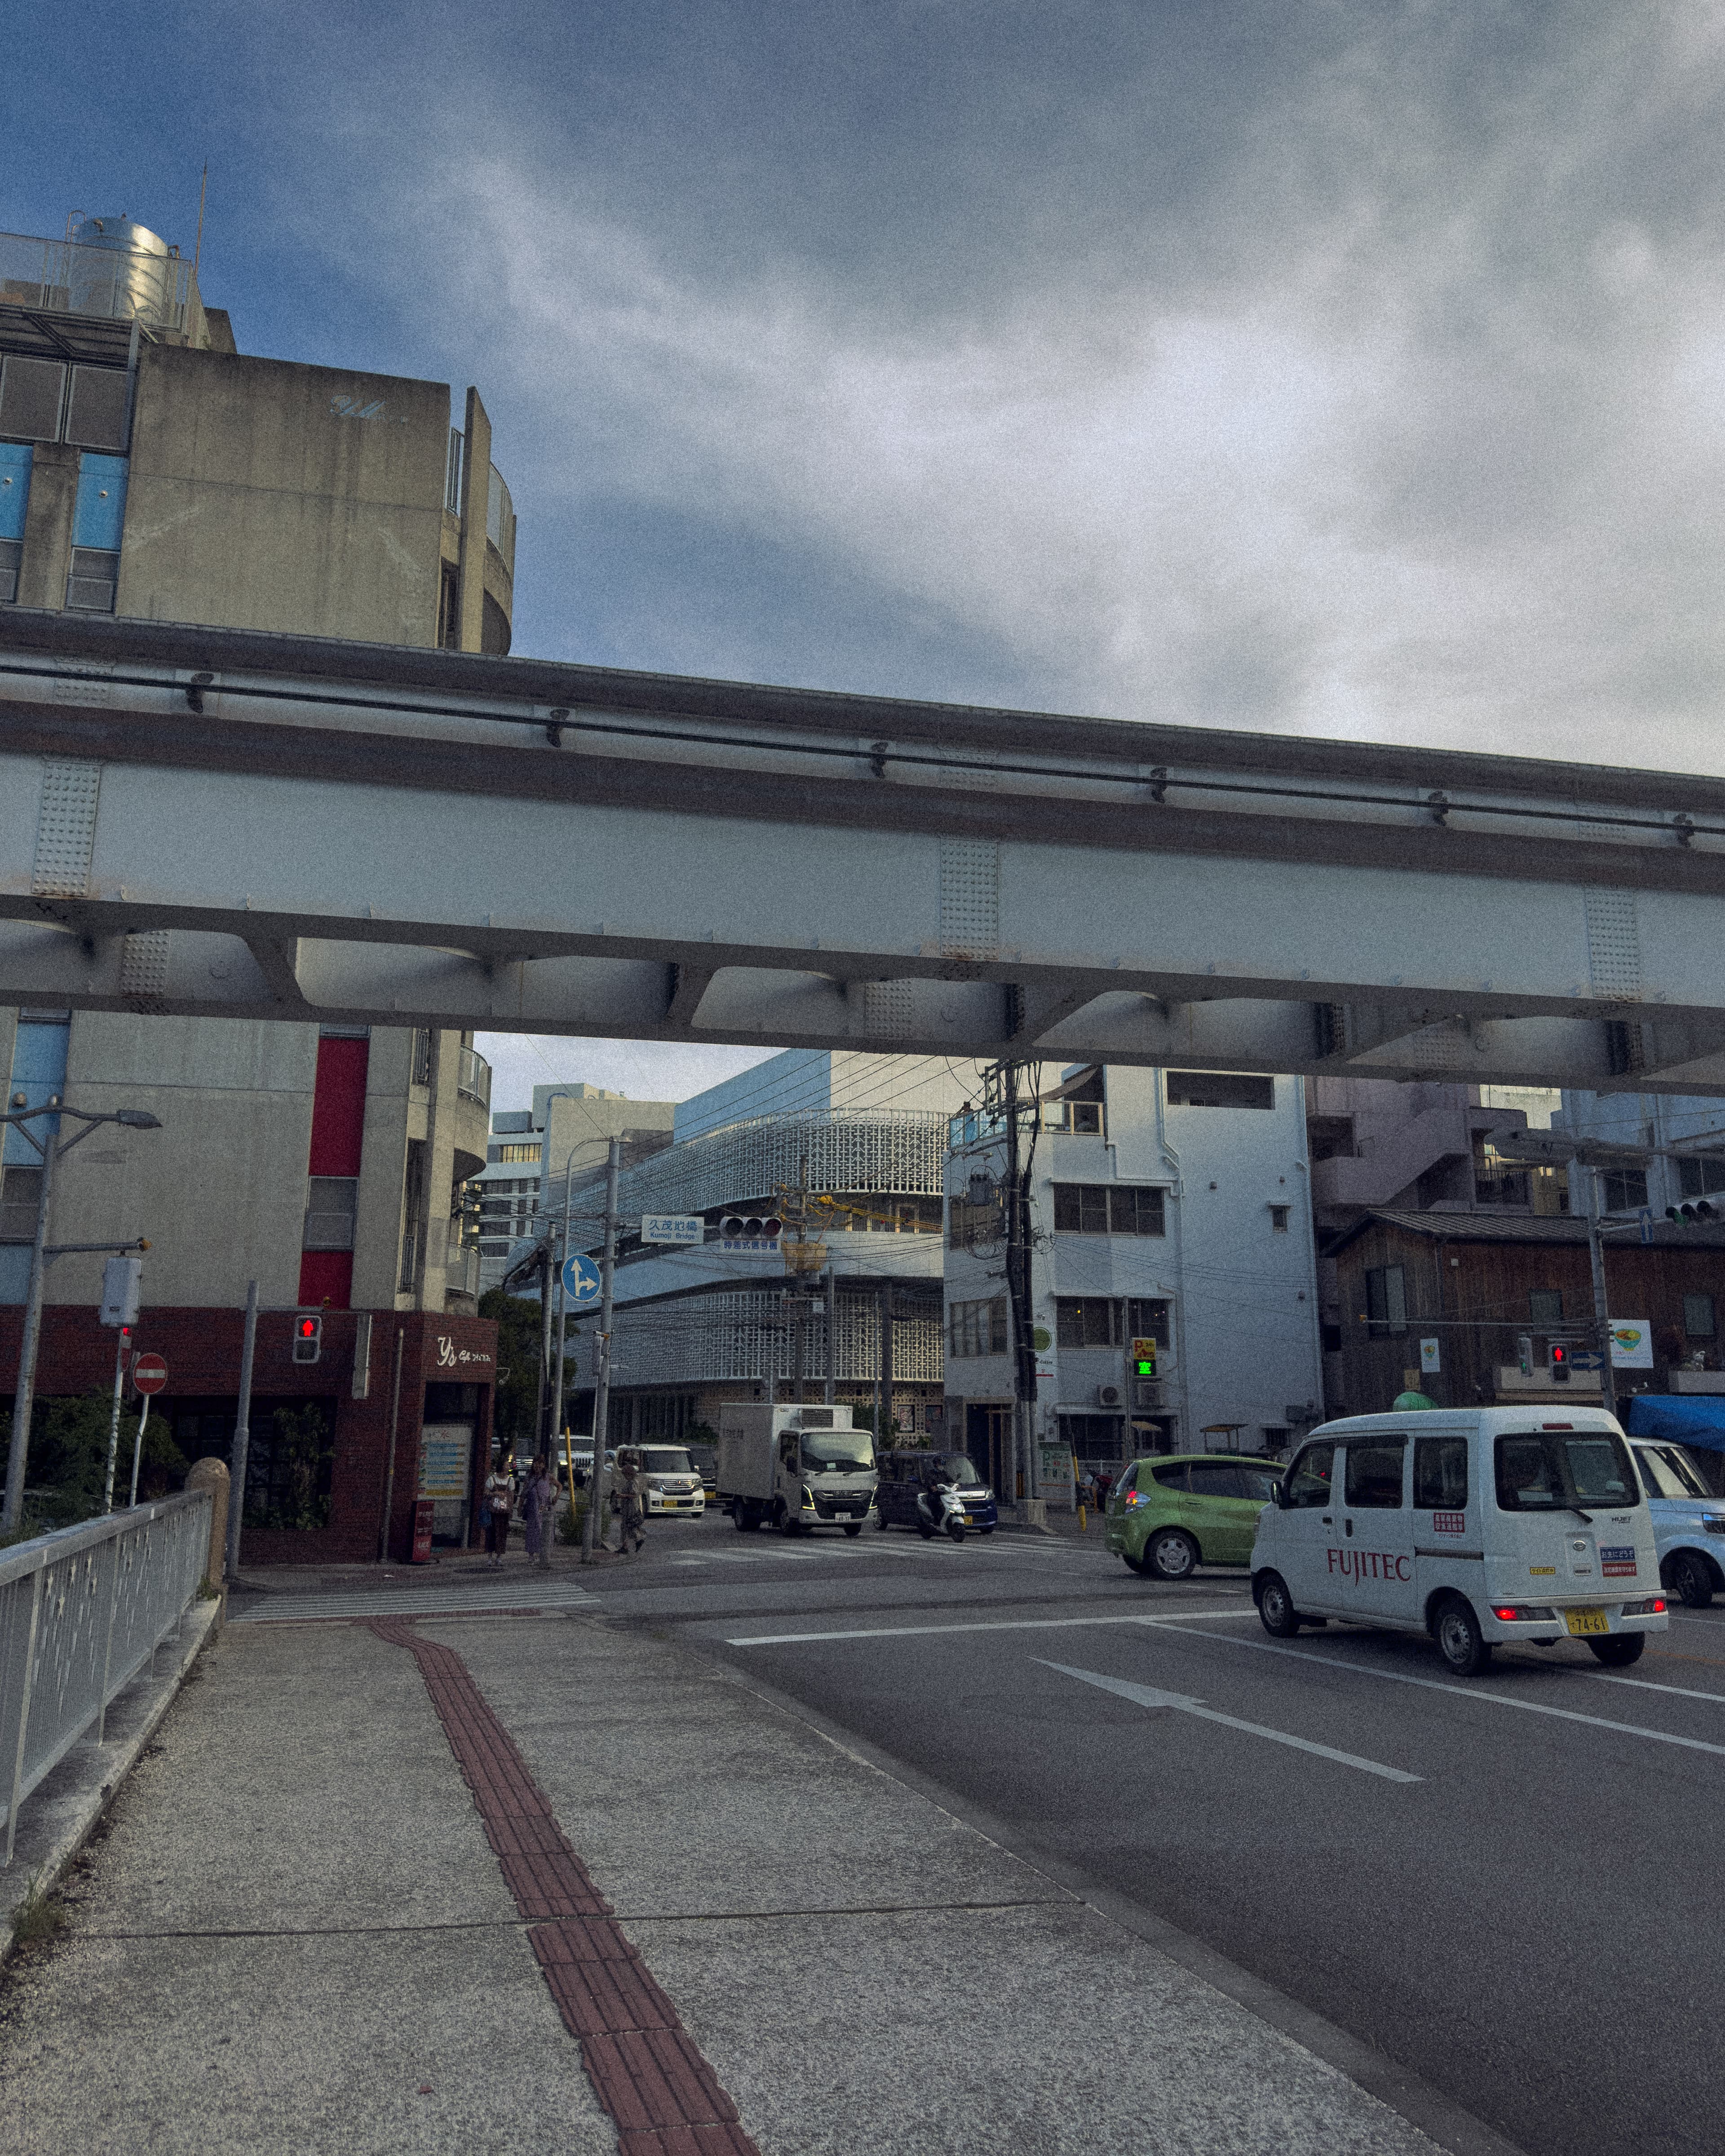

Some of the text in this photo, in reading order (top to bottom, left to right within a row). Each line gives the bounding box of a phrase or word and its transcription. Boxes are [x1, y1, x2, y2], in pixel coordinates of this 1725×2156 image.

[649, 1219, 698, 1232] 久茂地橋
[724, 1241, 778, 1250] 時差式信号機
[1134, 1340, 1143, 1352] P
[1139, 1361, 1151, 1374] 空
[1601, 1550, 1634, 1558] お先にどうぞ
[1327, 1549, 1411, 1587] FUJITEC
[1575, 1617, 1605, 1631] 74-61
